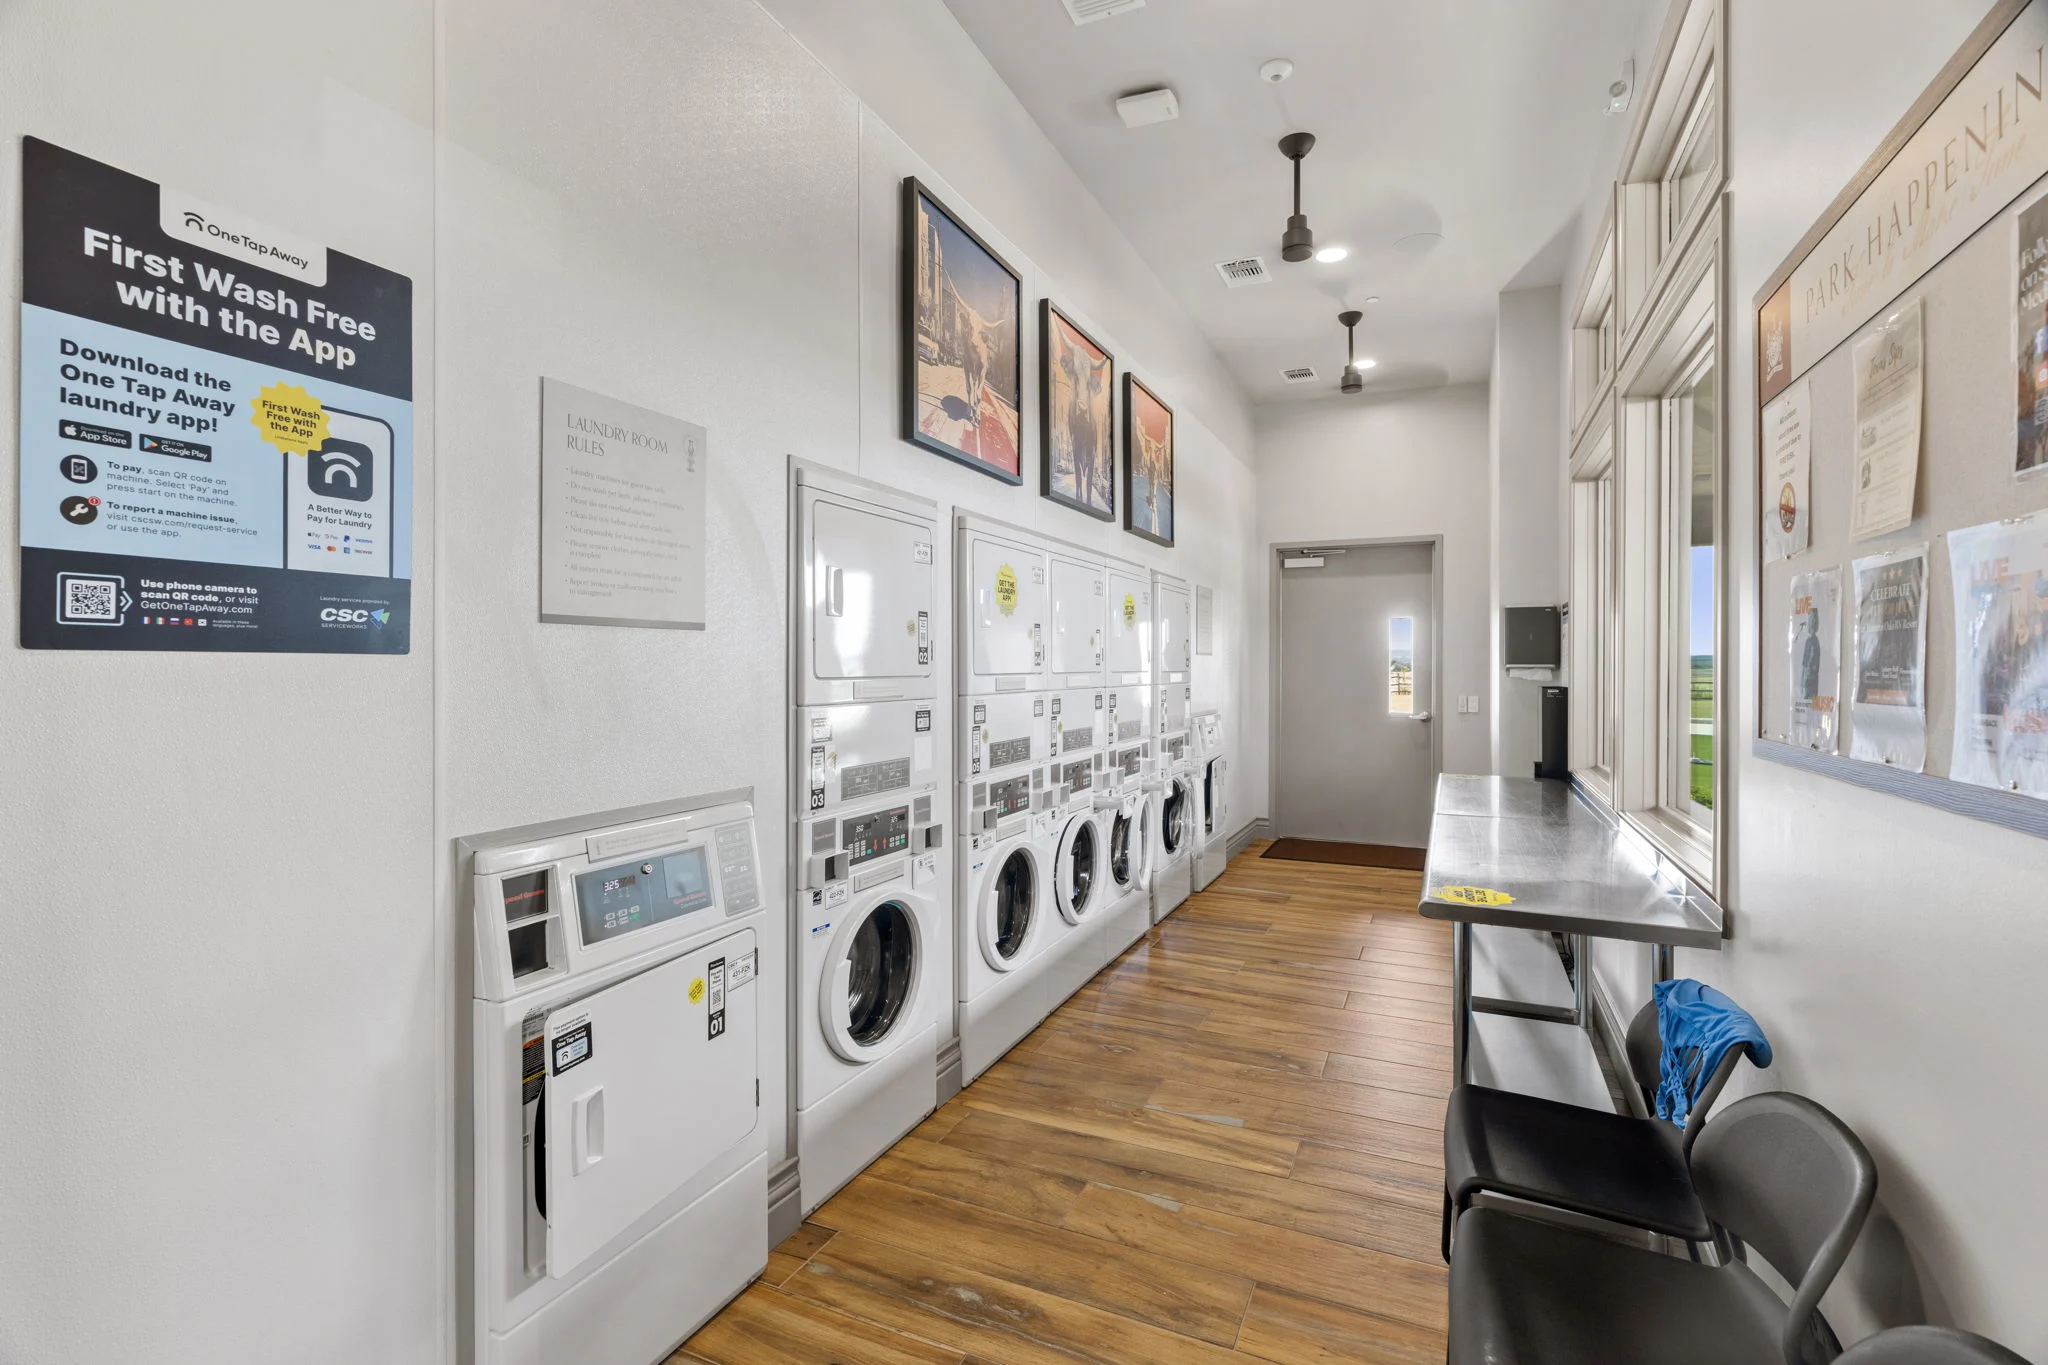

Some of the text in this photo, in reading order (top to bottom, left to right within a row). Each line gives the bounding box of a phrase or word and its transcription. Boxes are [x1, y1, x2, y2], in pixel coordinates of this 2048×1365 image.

[84, 227, 376, 341] First Wash Free
[1805, 245, 1856, 324] PARK
[116, 281, 356, 370] with the App
[60, 338, 231, 392] Download the
[60, 363, 236, 417] One Tap Away
[60, 387, 218, 433] laundry app!
[262, 399, 320, 420] First Wash
[266, 411, 317, 429] Free with
[80, 430, 127, 445] App Store
[270, 421, 313, 438] the App
[567, 413, 669, 454] LAUNDRY ROOM
[161, 445, 208, 460] Google Play
[567, 434, 605, 456] RULES
[107, 461, 227, 486] To pay, scan QR code on
[107, 472, 152, 485] machine.
[155, 478, 186, 490] Select
[212, 487, 229, 496] and
[107, 483, 238, 507] press start on the machine.
[107, 501, 120, 510] To
[122, 504, 155, 516] report
[166, 509, 208, 521] machine
[210, 513, 239, 525] issue,
[316, 505, 342, 516] Better
[344, 509, 362, 518] Way
[106, 512, 258, 536] visit cscsw.com/request-service
[107, 524, 182, 538] or use the app.
[307, 514, 372, 530] Pay for Laundry
[140, 579, 257, 595] Use phone camera to
[997, 586, 1016, 596] LAUNDRY
[999, 579, 1007, 588] GET
[1870, 583, 1911, 601] CELEBRATE
[140, 591, 170, 599] scan
[172, 592, 189, 601] QR
[191, 593, 222, 604] code,
[238, 596, 259, 605] visit
[140, 600, 253, 614] GetOneTapAway.com
[320, 607, 369, 623] CSC
[919, 652, 928, 664] 02
[973, 762, 980, 773] 05
[811, 793, 824, 808] 03
[710, 1016, 723, 1035] 01
[556, 1039, 566, 1049] One
[566, 1035, 575, 1045] Tap
